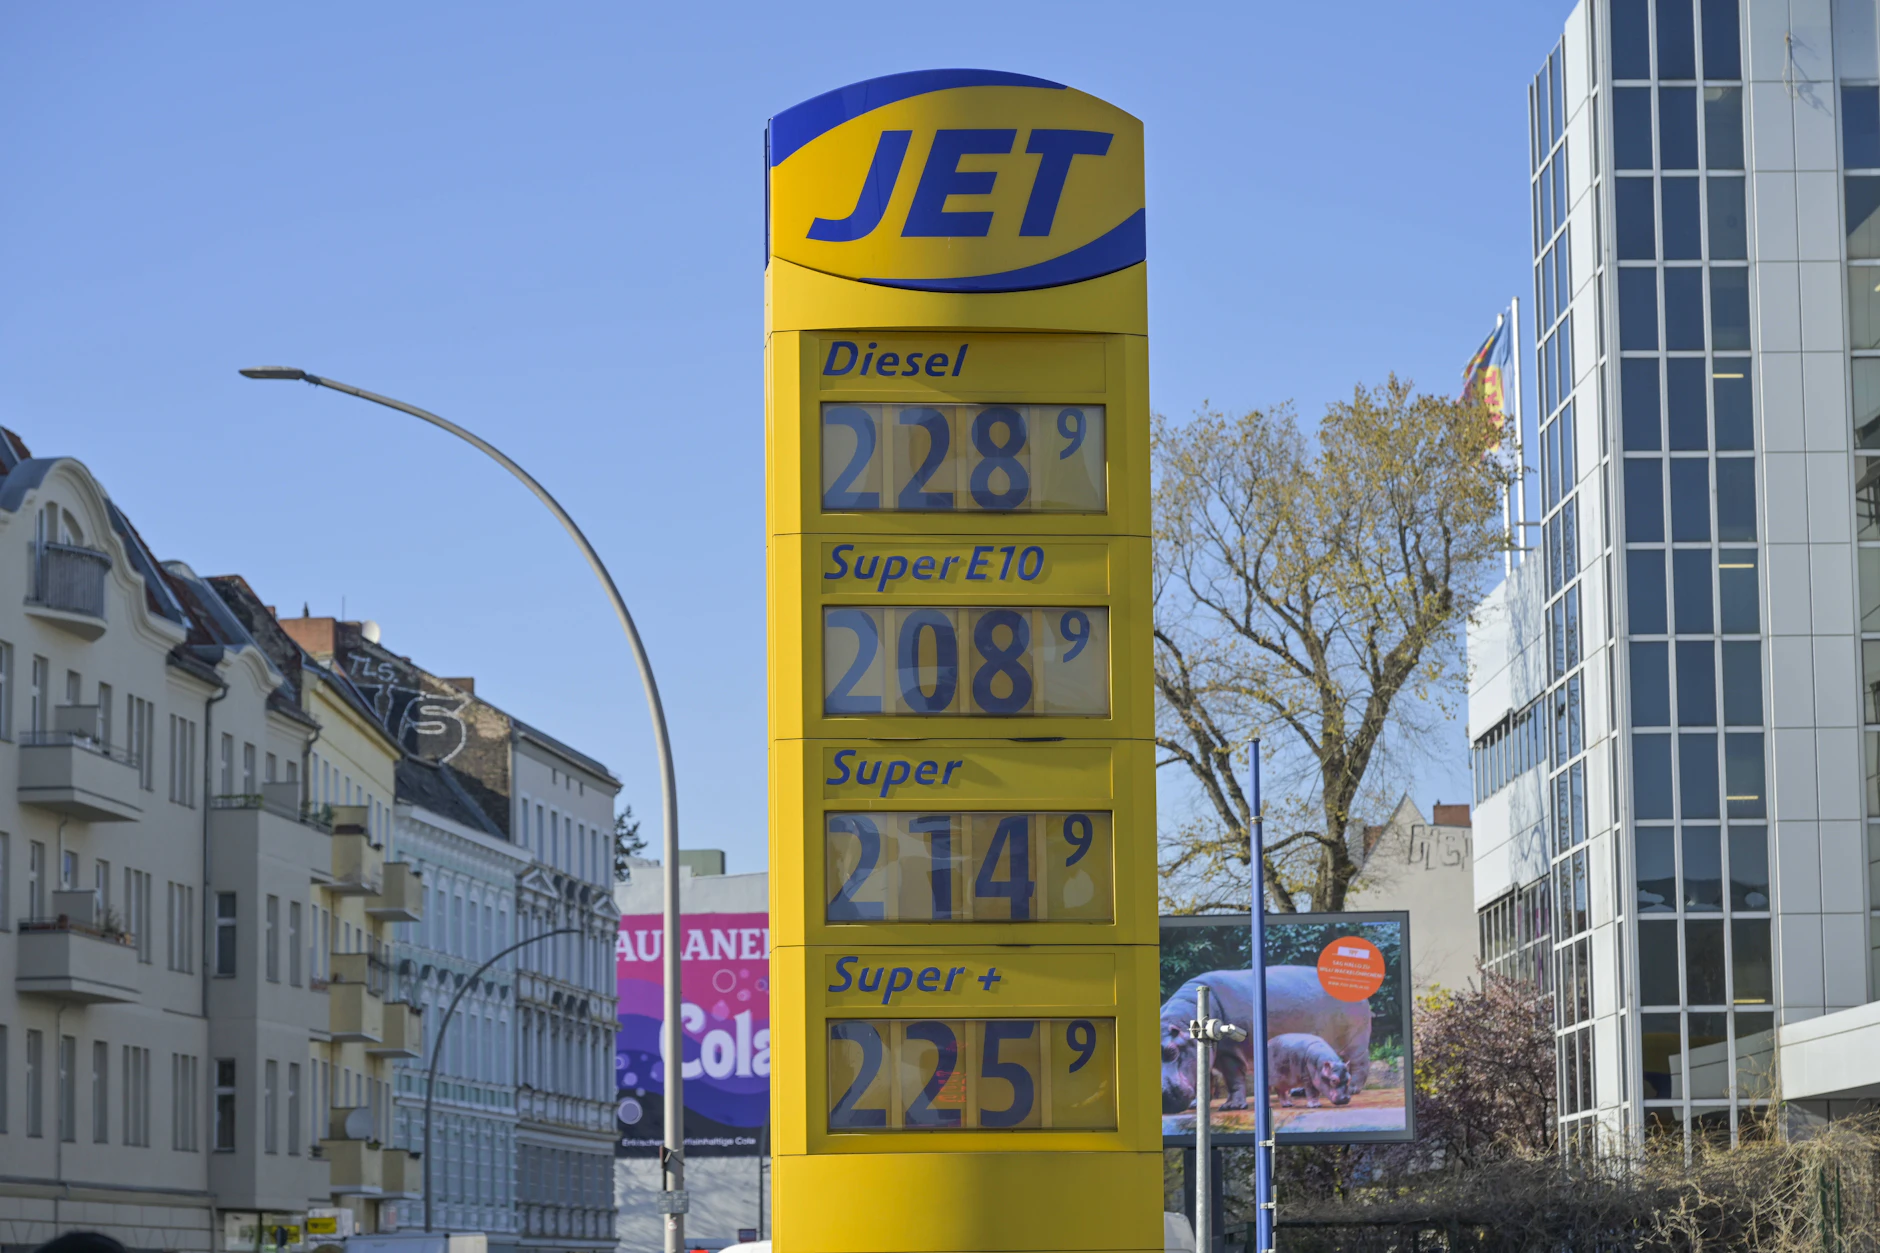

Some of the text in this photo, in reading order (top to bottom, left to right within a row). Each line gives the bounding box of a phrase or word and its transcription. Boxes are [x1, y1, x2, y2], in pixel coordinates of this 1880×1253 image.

[806, 128, 1114, 242] JET
[822, 341, 968, 376] Diesel
[824, 544, 1045, 592] Super E10
[826, 750, 963, 798] Super
[616, 928, 770, 962] AUANE
[828, 956, 965, 1005] Super
